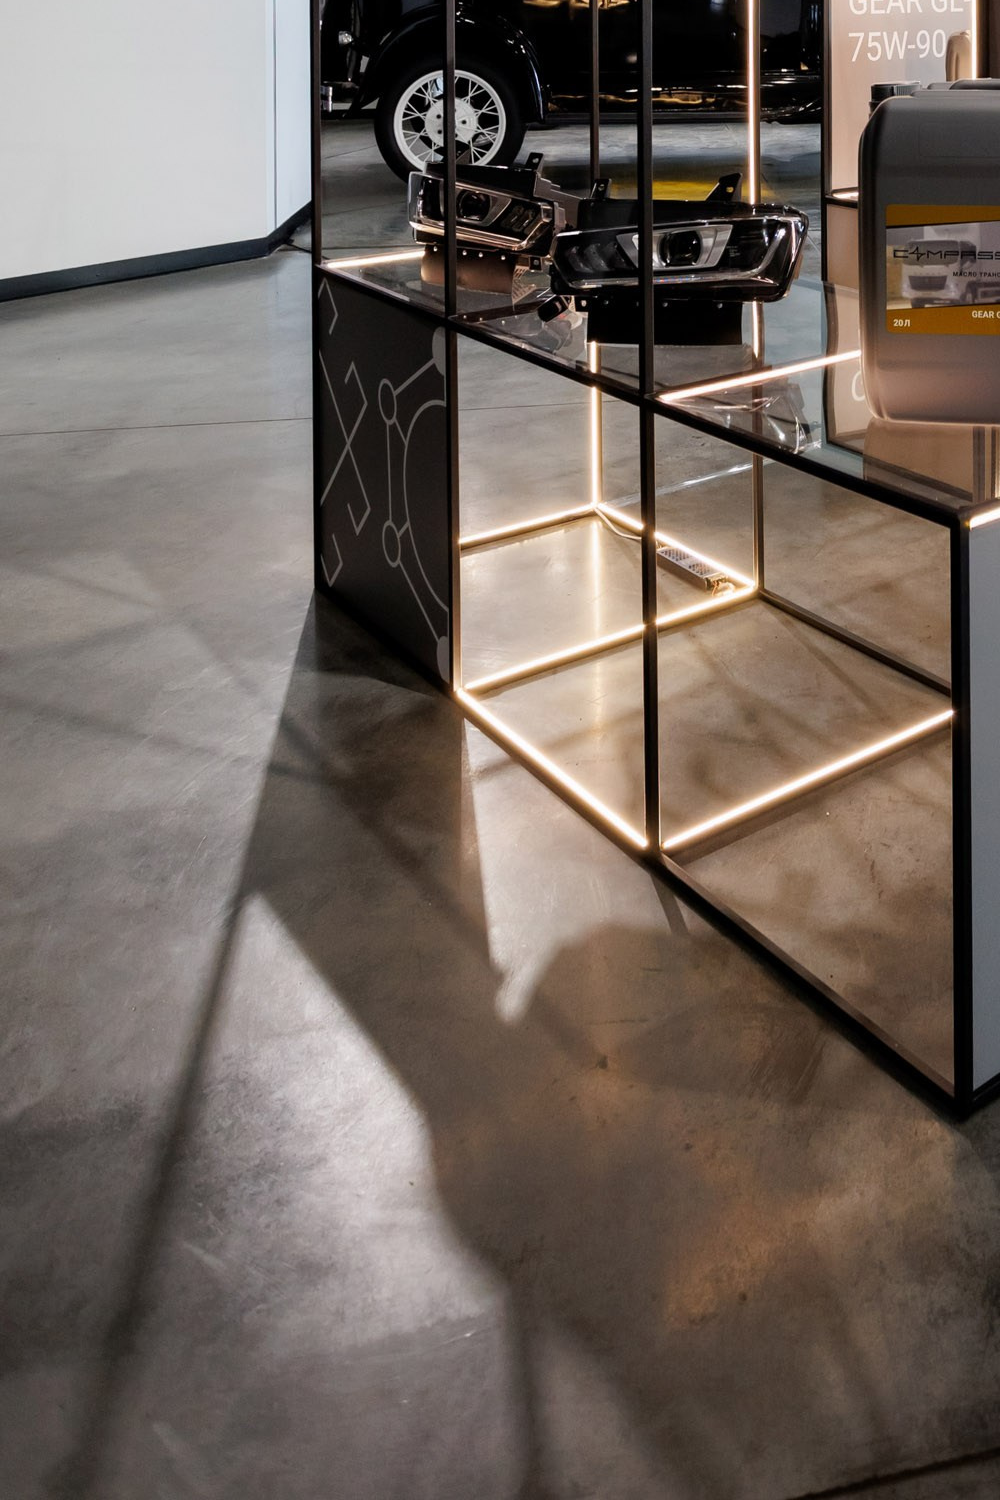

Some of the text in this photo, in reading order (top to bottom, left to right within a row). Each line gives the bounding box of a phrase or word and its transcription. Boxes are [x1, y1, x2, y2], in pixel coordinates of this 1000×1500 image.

[848, 29, 947, 62] 75W-90
[971, 310, 994, 319] GEAR
[893, 319, 911, 327] 20Л
